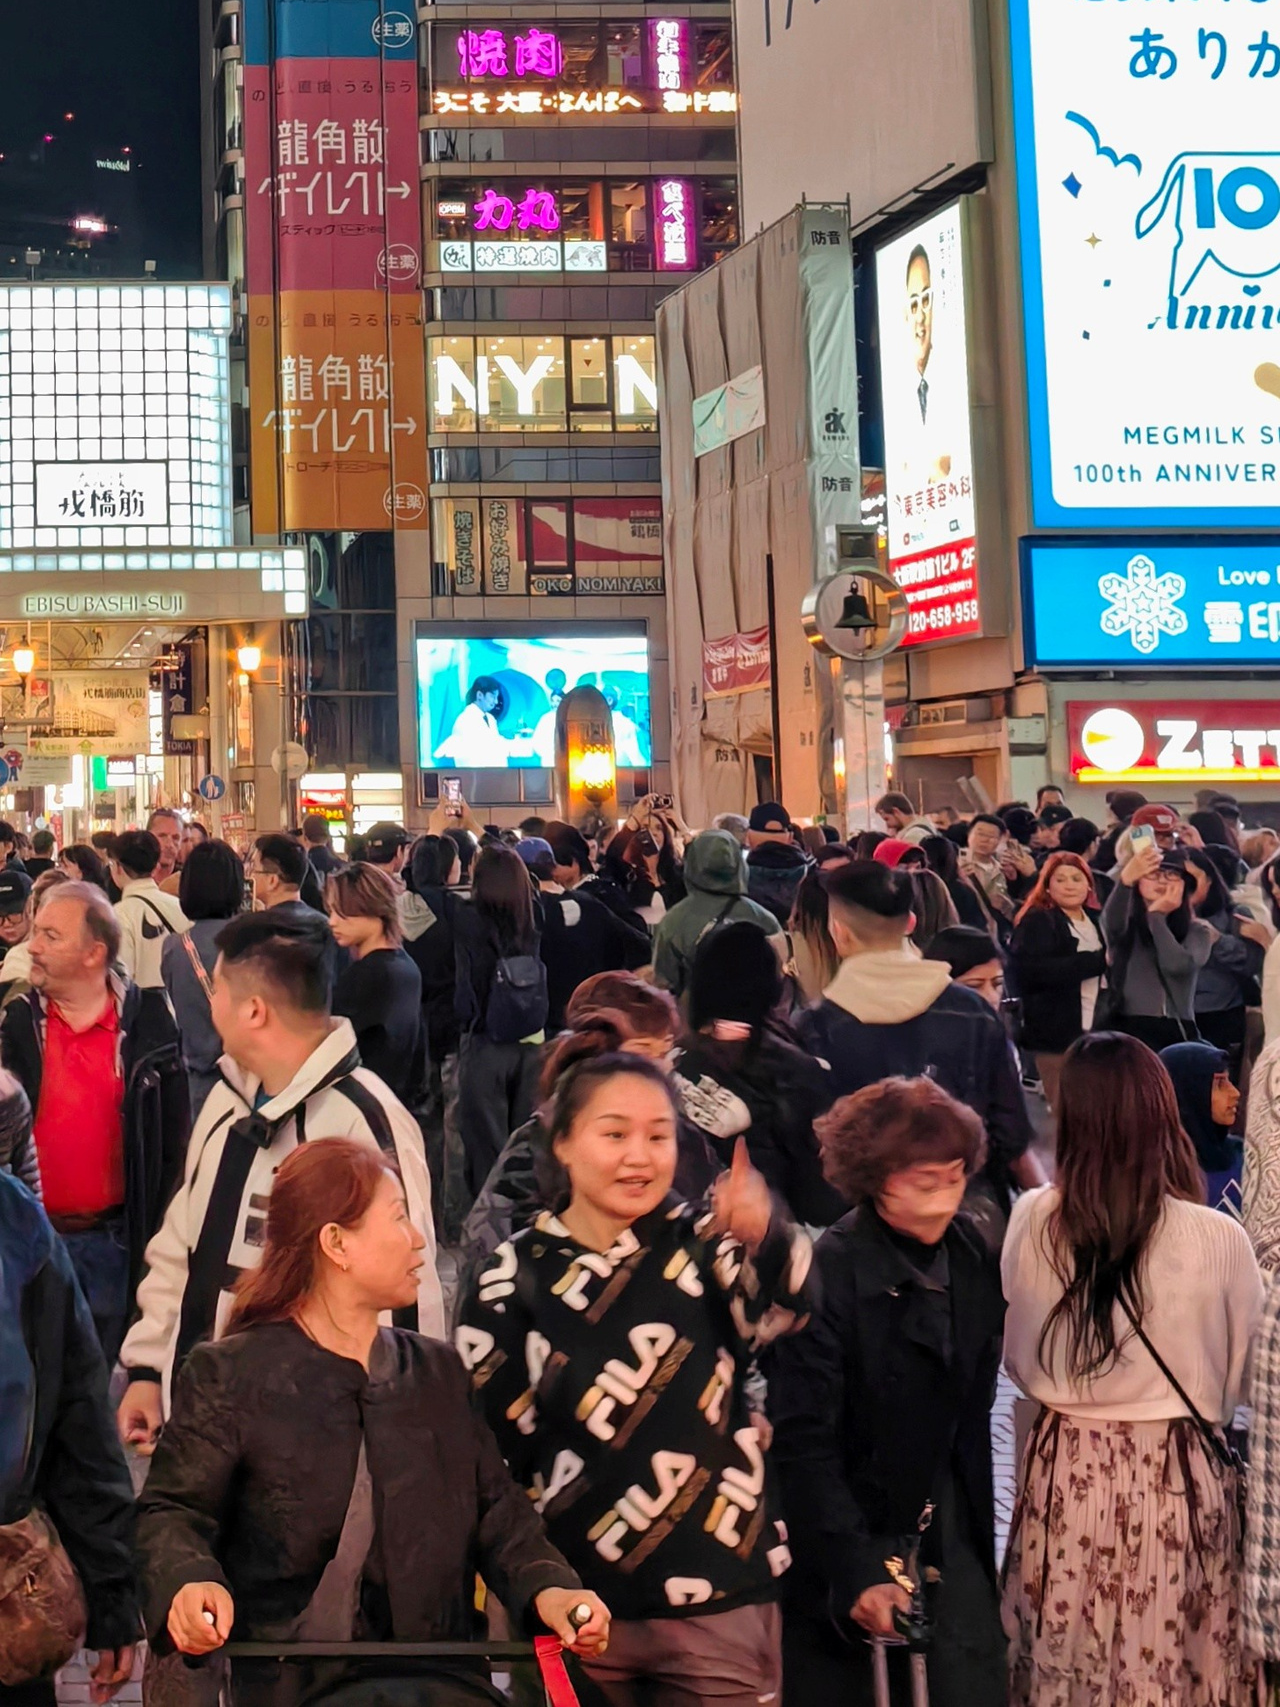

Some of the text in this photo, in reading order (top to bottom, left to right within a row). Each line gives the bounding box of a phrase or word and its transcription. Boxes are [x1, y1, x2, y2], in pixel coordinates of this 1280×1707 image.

[277, 118, 389, 167] 龍角散
[257, 170, 411, 217] ダイレクト
[473, 187, 561, 232] 力丸
[810, 229, 842, 247] 防音
[1147, 293, 1280, 331] Anni
[279, 353, 395, 402] 龍角散
[262, 407, 418, 454] ダイレクト
[1123, 425, 1280, 445] MEGMILK S
[821, 476, 854, 493] 防音
[1073, 462, 1277, 483] 100th ANNIVER
[453, 509, 476, 586] 焼きそば
[488, 500, 511, 592] お好み焼き
[1217, 564, 1272, 587] Love
[25, 595, 183, 615] EBISU BASHI-SUJI
[576, 1322, 677, 1443] FILA
[586, 1449, 697, 1563] FILA
